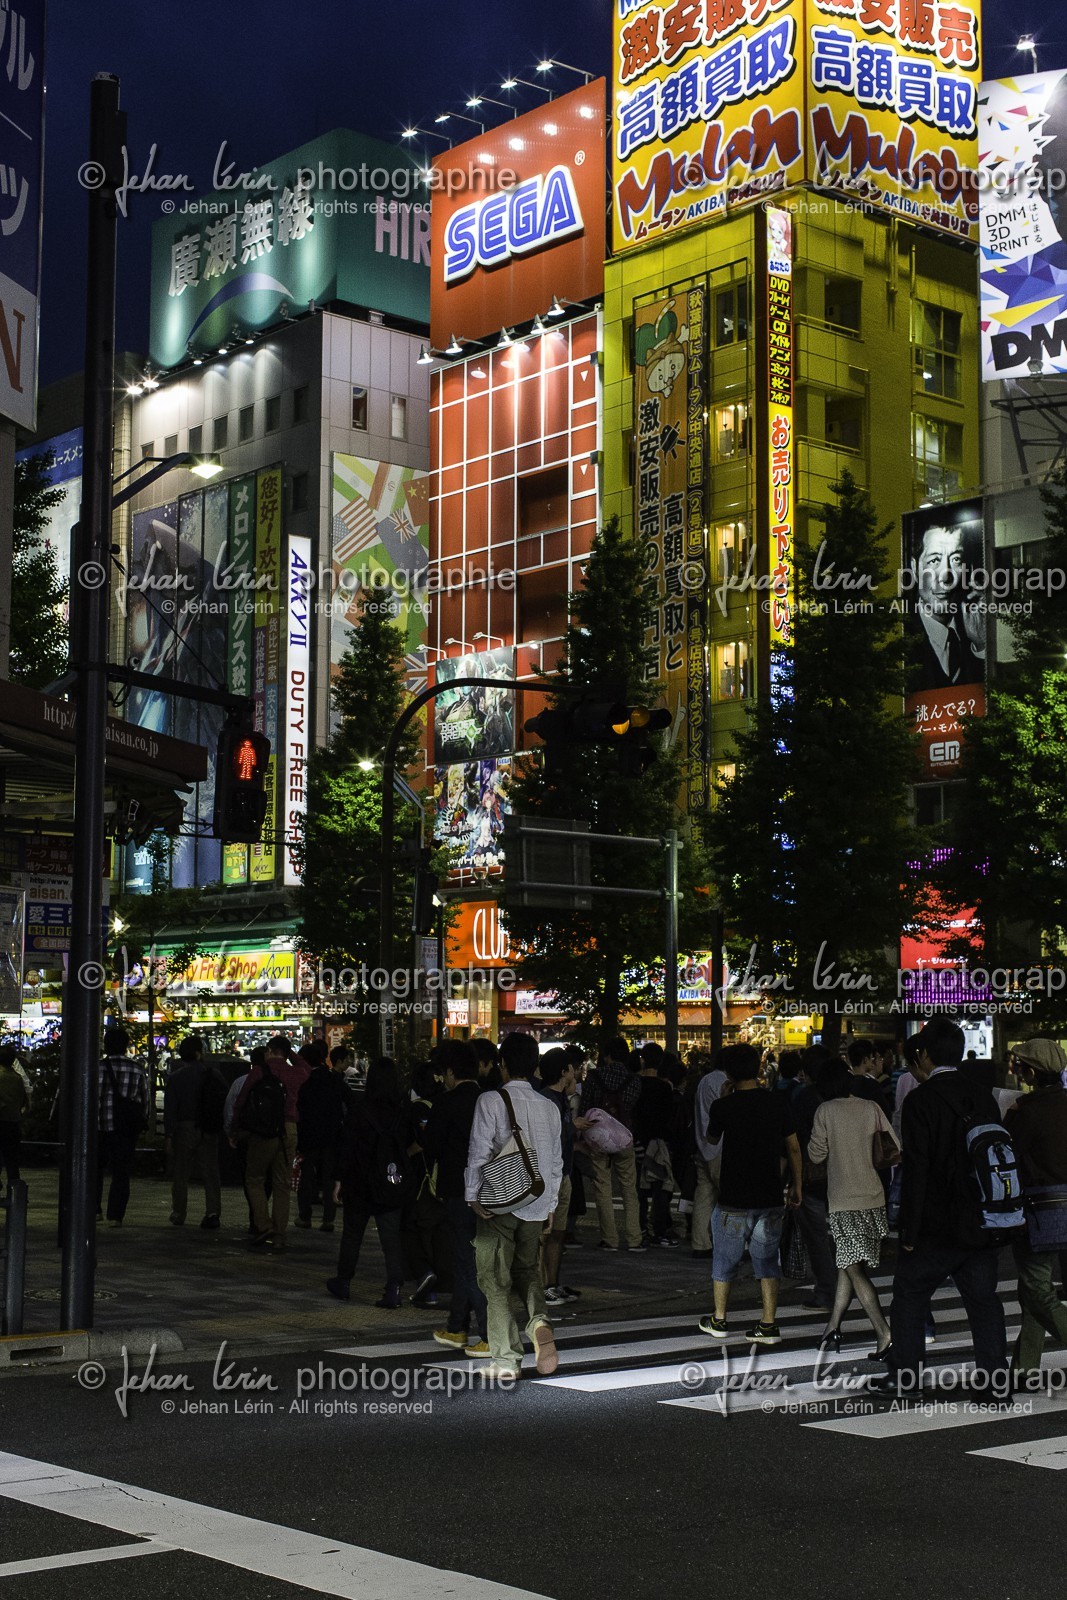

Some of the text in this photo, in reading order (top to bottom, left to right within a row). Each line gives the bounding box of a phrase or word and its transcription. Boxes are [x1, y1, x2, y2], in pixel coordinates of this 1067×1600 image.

[619, 19, 790, 155] 高額買取
[814, 29, 973, 129] 高額買取
[687, 193, 726, 219] AKIBA
[985, 206, 1027, 228] DMM
[444, 165, 584, 282] SEGA
[988, 226, 1011, 243] 3D
[989, 235, 1030, 255] PRINT
[769, 276, 790, 293] DVD
[769, 304, 791, 321] ゲーム
[772, 320, 787, 334] CD
[769, 346, 791, 362] アニメ
[290, 548, 308, 631] AKKY
[662, 492, 685, 672] 高額買取と
[291, 670, 305, 733] DUTY
[289, 742, 304, 803] FREE
[200, 957, 227, 978] Free
[228, 955, 259, 981] Shop
